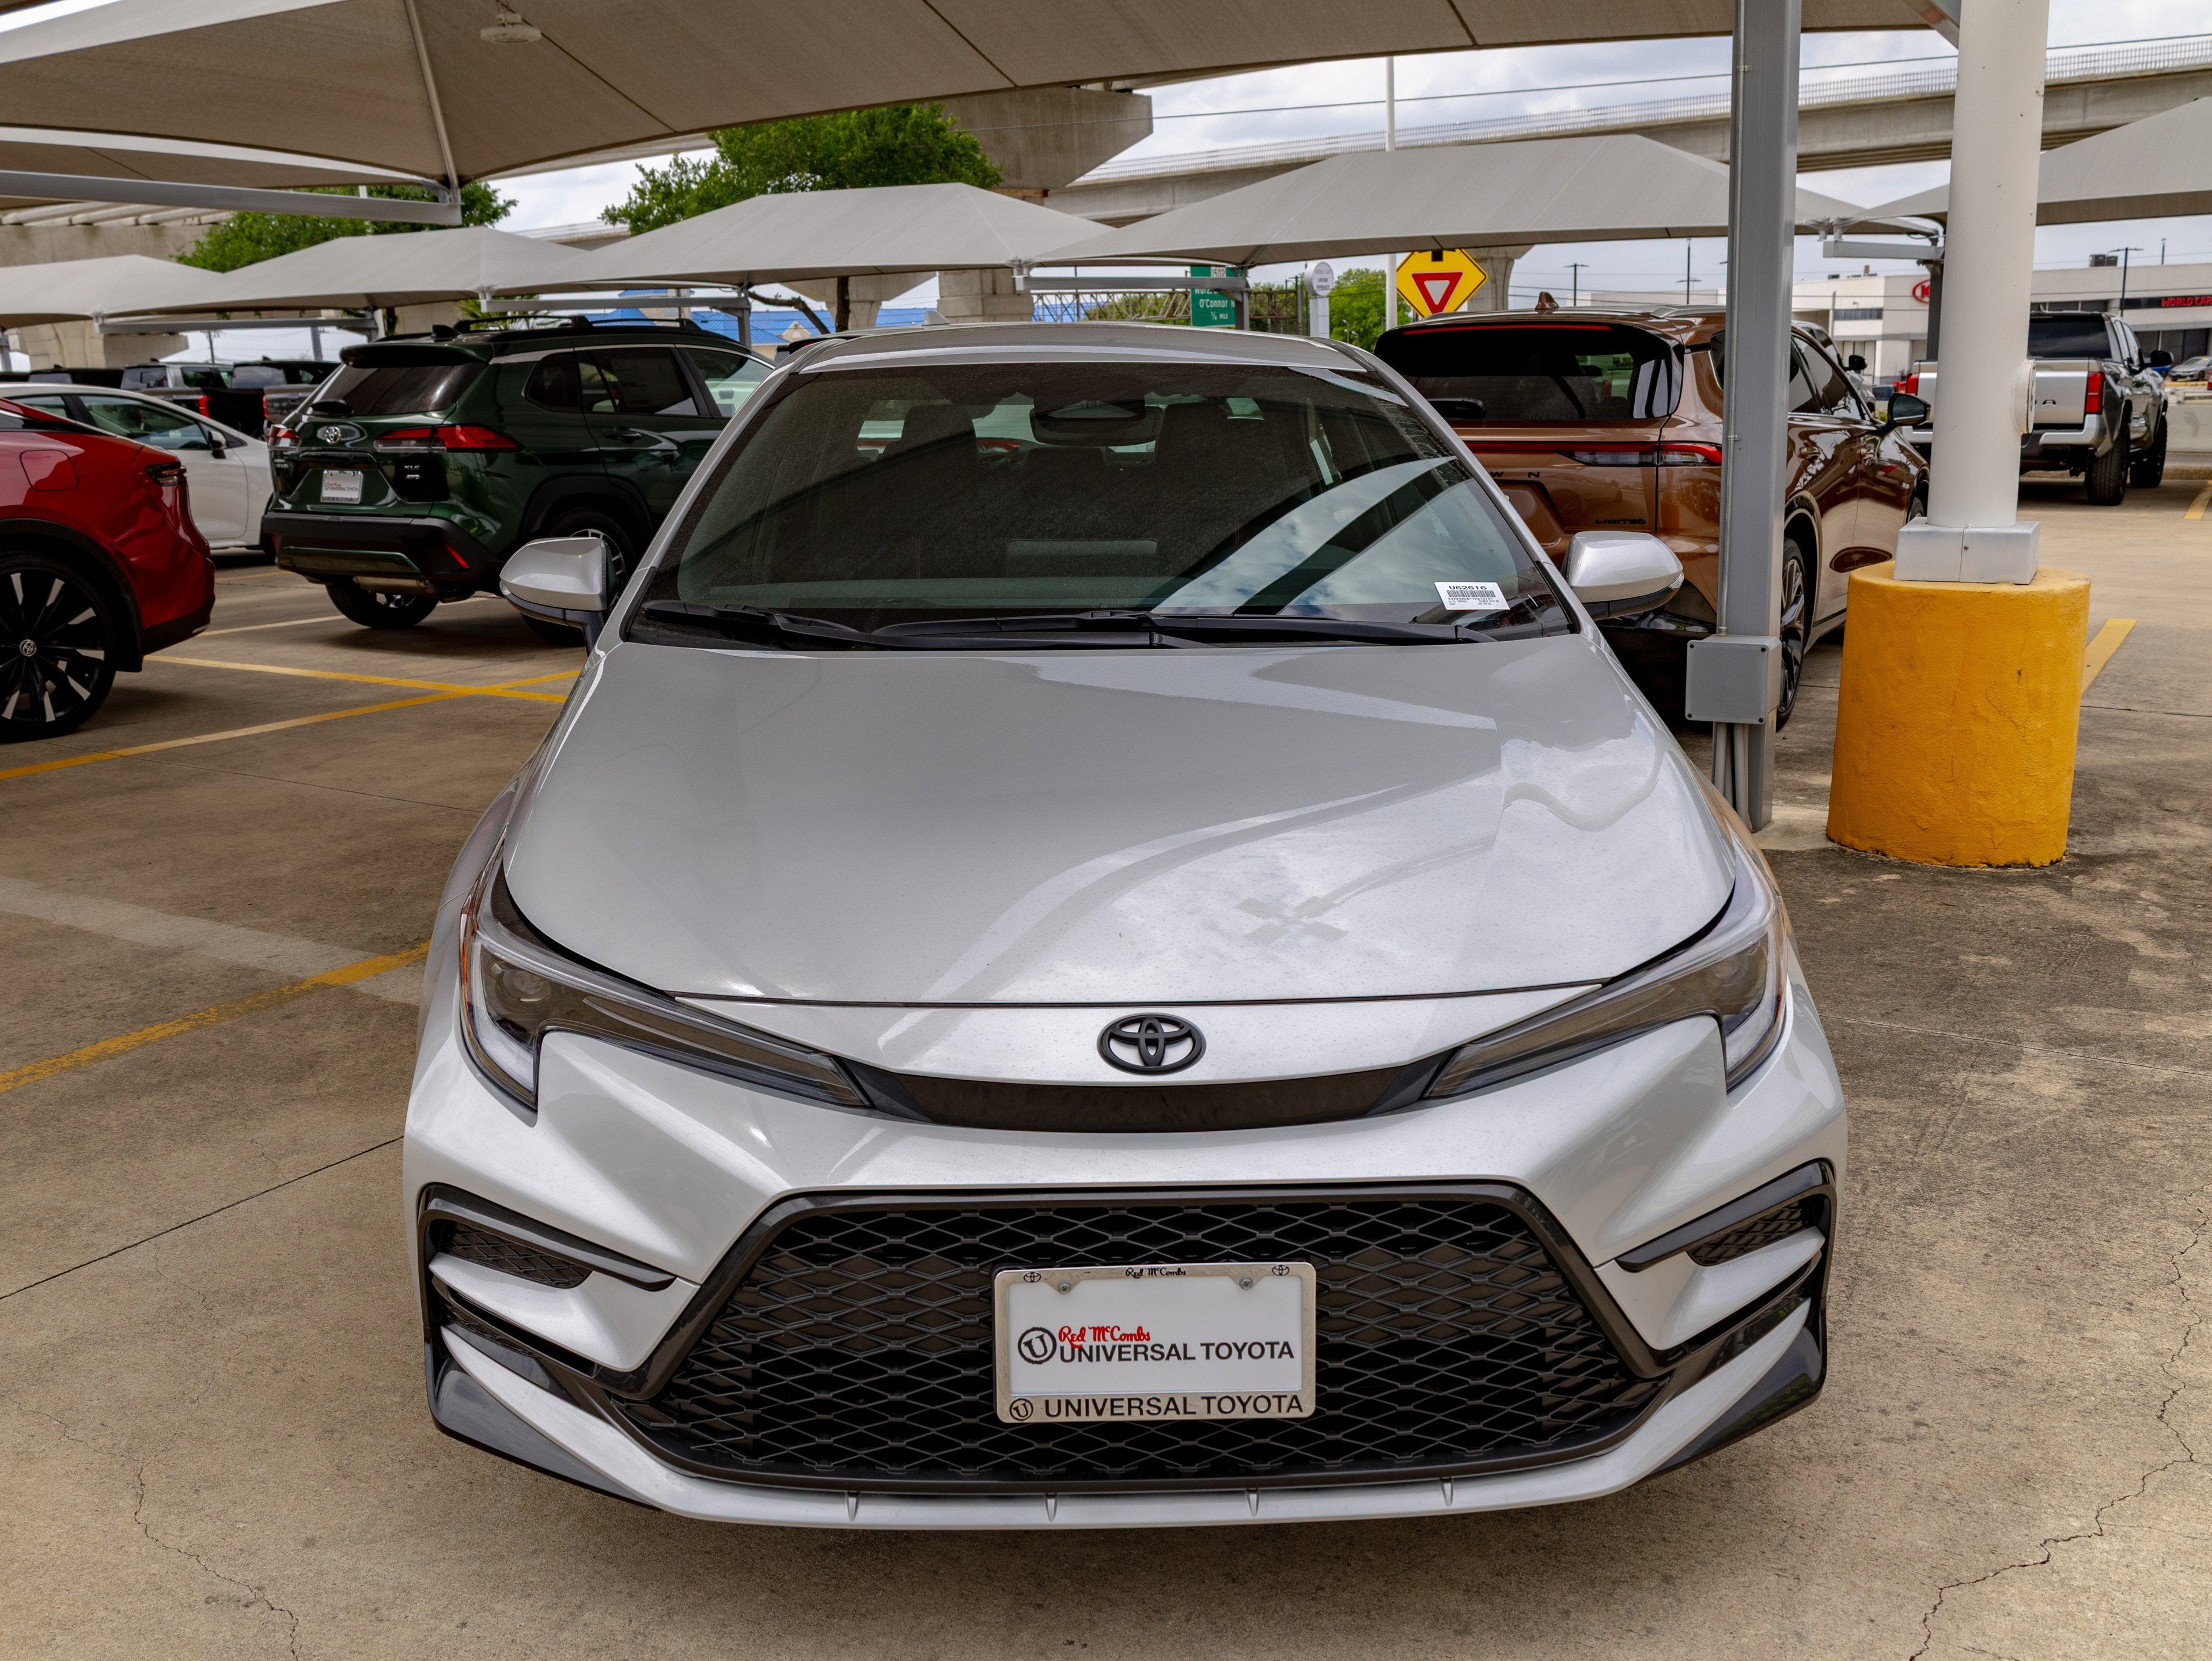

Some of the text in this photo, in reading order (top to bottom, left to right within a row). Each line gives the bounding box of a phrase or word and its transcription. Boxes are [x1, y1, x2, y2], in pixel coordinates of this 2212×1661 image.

[1211, 269, 1225, 278] 1502
[1199, 298, 1228, 308] O'Connor
[2161, 296, 2212, 307] WORLD CAR
[1125, 1267, 1186, 1279] Red McCombs
[1058, 1326, 1150, 1349] Red McCombs
[1059, 1341, 1295, 1363] UNIVERSAL TOYOTA
[1044, 1394, 1304, 1417] UNIVERSAL TOYOTA
